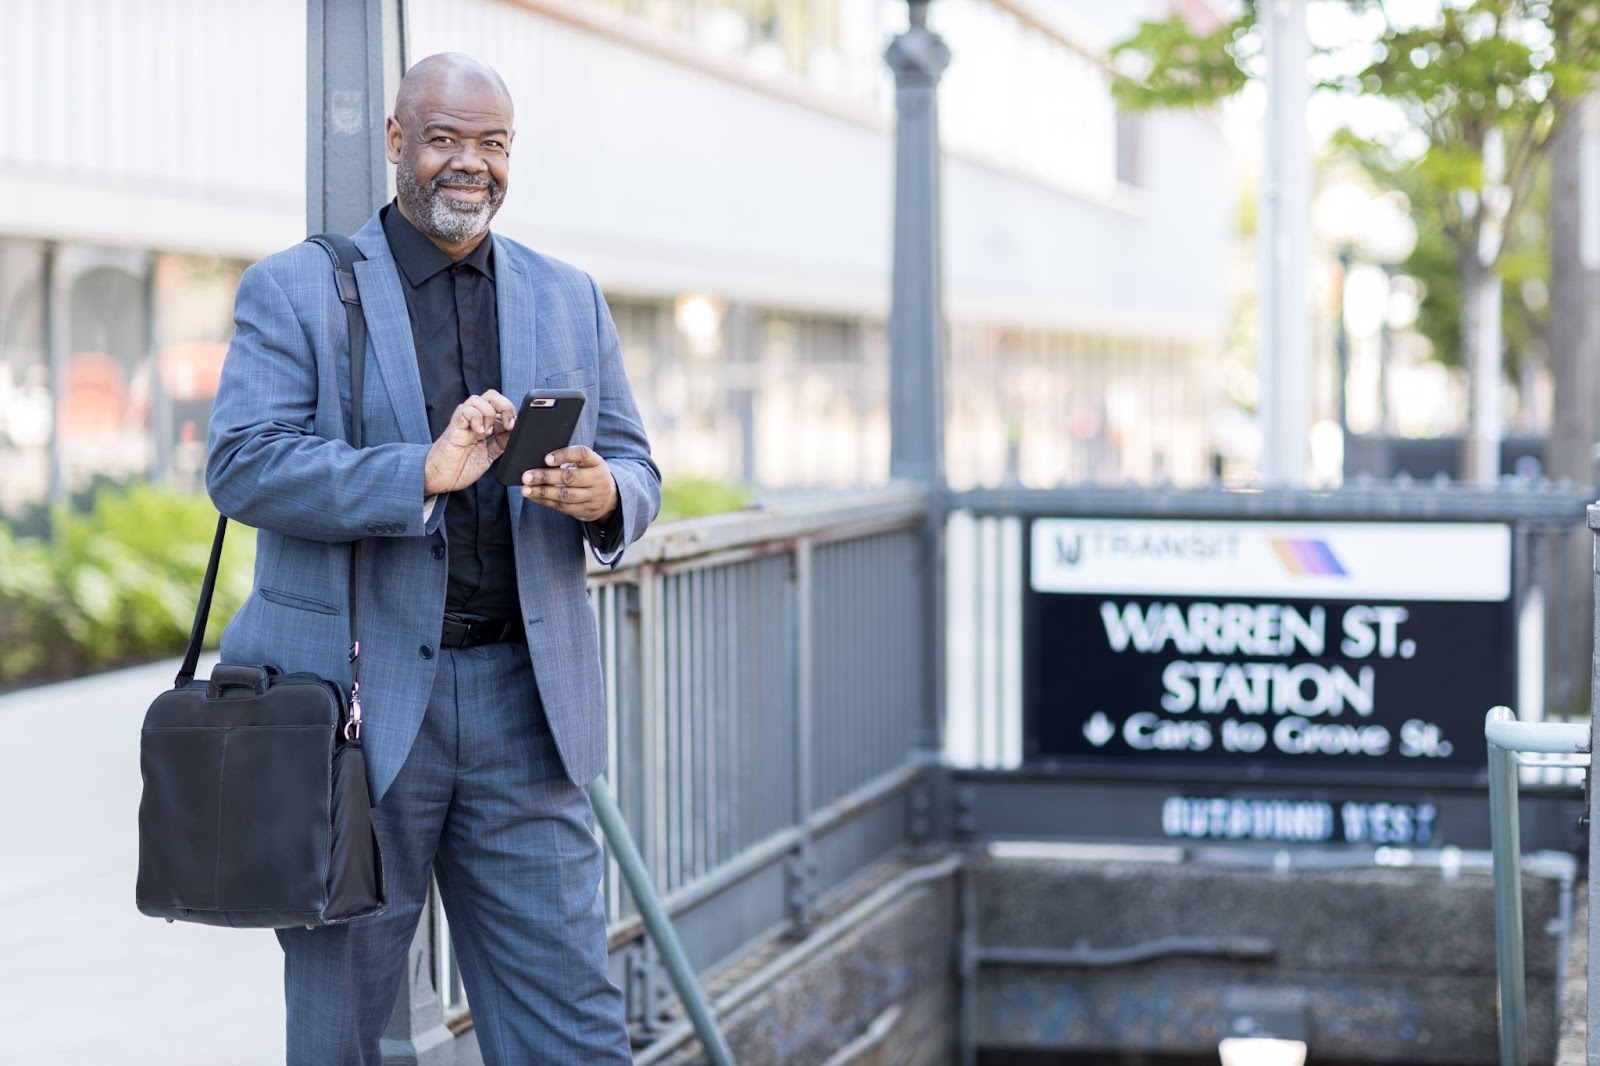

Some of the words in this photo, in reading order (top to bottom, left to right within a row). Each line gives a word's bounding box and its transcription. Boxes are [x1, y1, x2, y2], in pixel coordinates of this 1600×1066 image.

[1101, 602, 1325, 656] WARREN
[1341, 605, 1417, 659] ST.
[1161, 660, 1375, 717] STATION
[1123, 712, 1213, 751] Cars
[1221, 718, 1267, 753] to
[1273, 715, 1391, 755] Grove
[1400, 718, 1454, 758] St.
